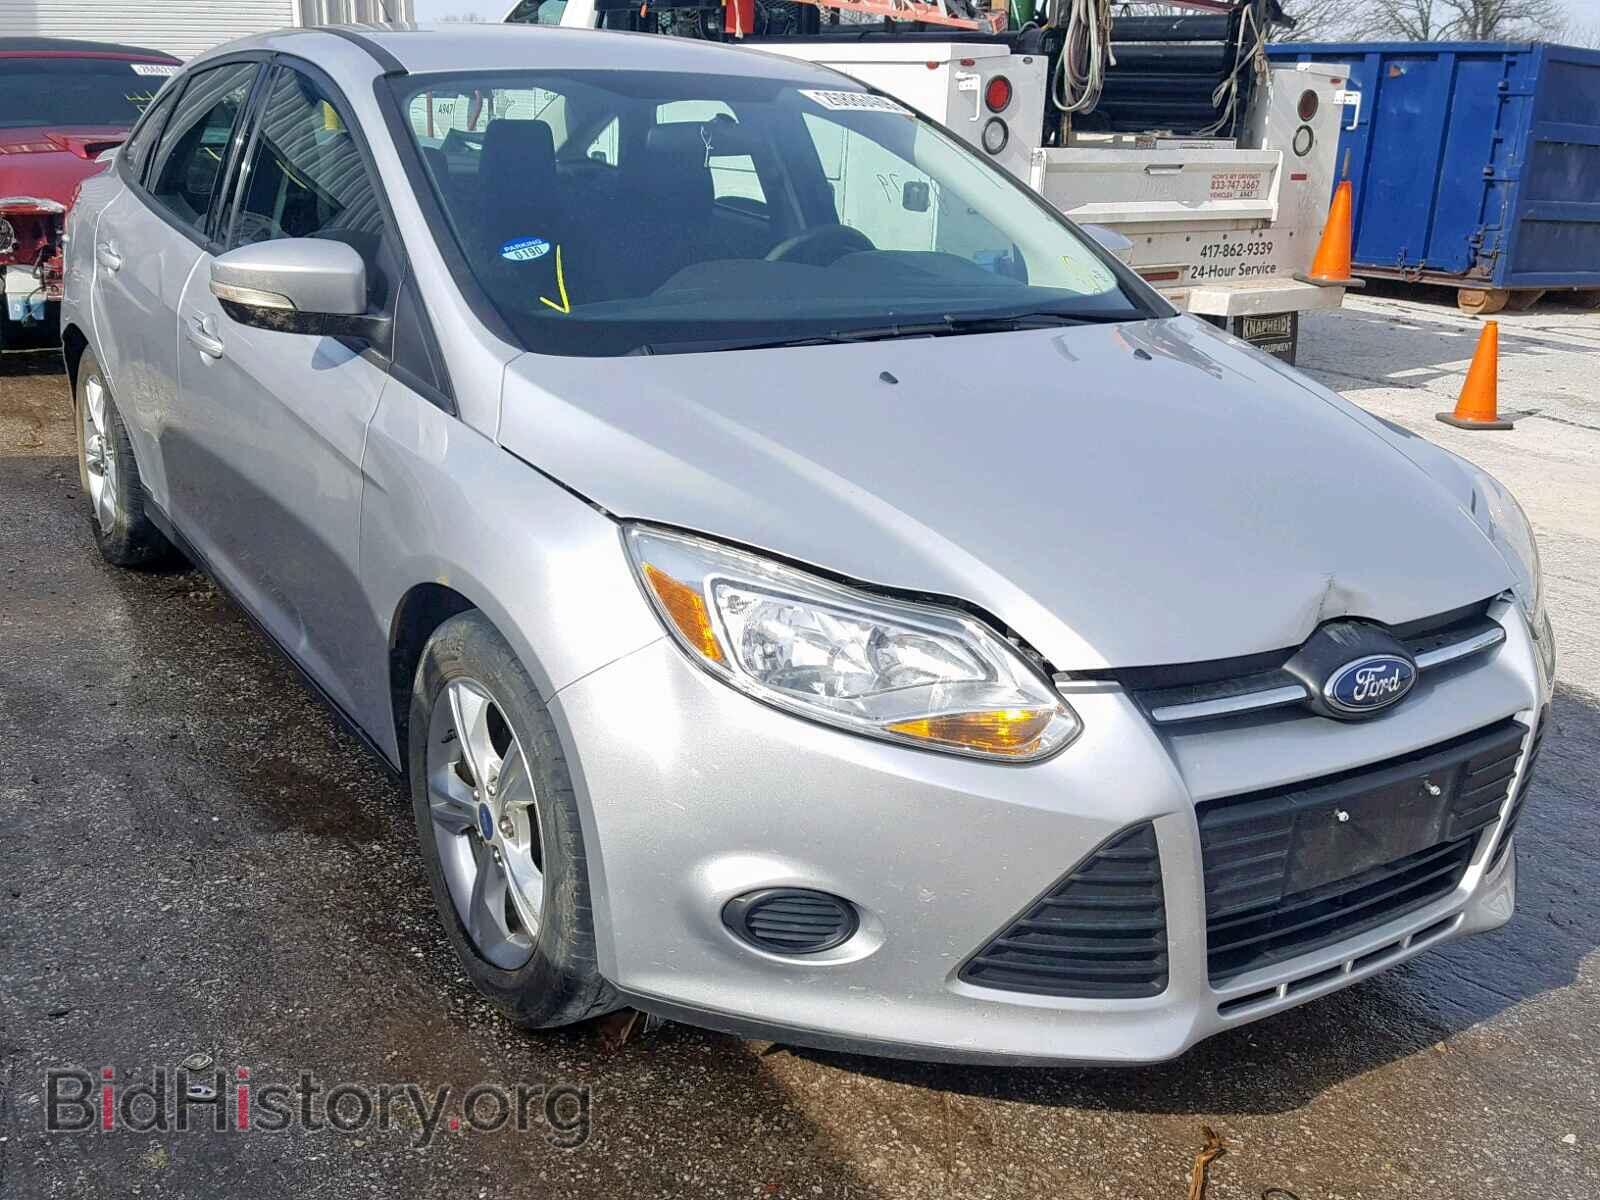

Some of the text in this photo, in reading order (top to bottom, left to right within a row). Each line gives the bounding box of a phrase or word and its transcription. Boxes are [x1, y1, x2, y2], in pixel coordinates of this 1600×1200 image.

[1211, 180, 1260, 190] 833-747-3667
[503, 239, 543, 252] PARKING
[1200, 241, 1274, 258] 417-862-9339
[1190, 261, 1277, 279] 24-Hour Service
[1242, 314, 1291, 338] KNAPHEIDE
[1353, 664, 1400, 701] Ford
